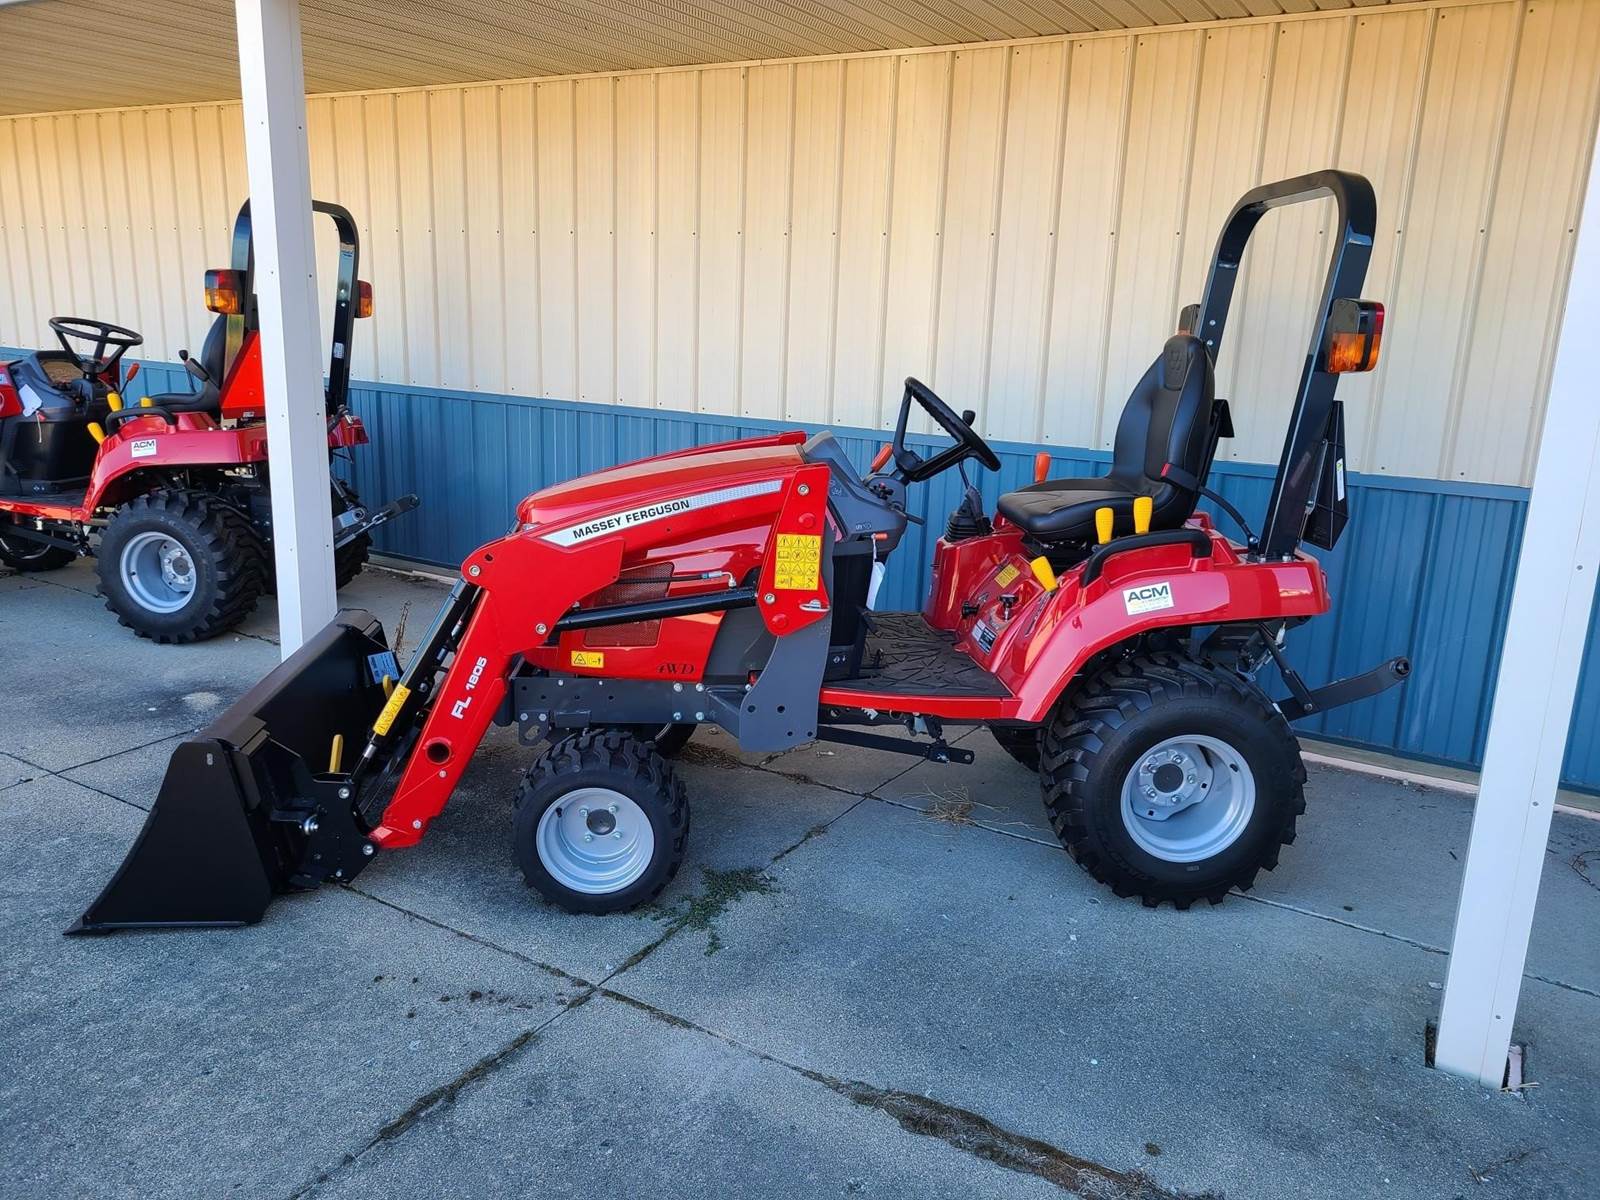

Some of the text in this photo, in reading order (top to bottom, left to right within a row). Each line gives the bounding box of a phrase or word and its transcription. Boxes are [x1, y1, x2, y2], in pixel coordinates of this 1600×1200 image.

[134, 440, 155, 449] ACM
[573, 500, 690, 539] MASSEY FERGUSON
[1128, 585, 1169, 602] ACM
[451, 656, 487, 719] FL 1805
